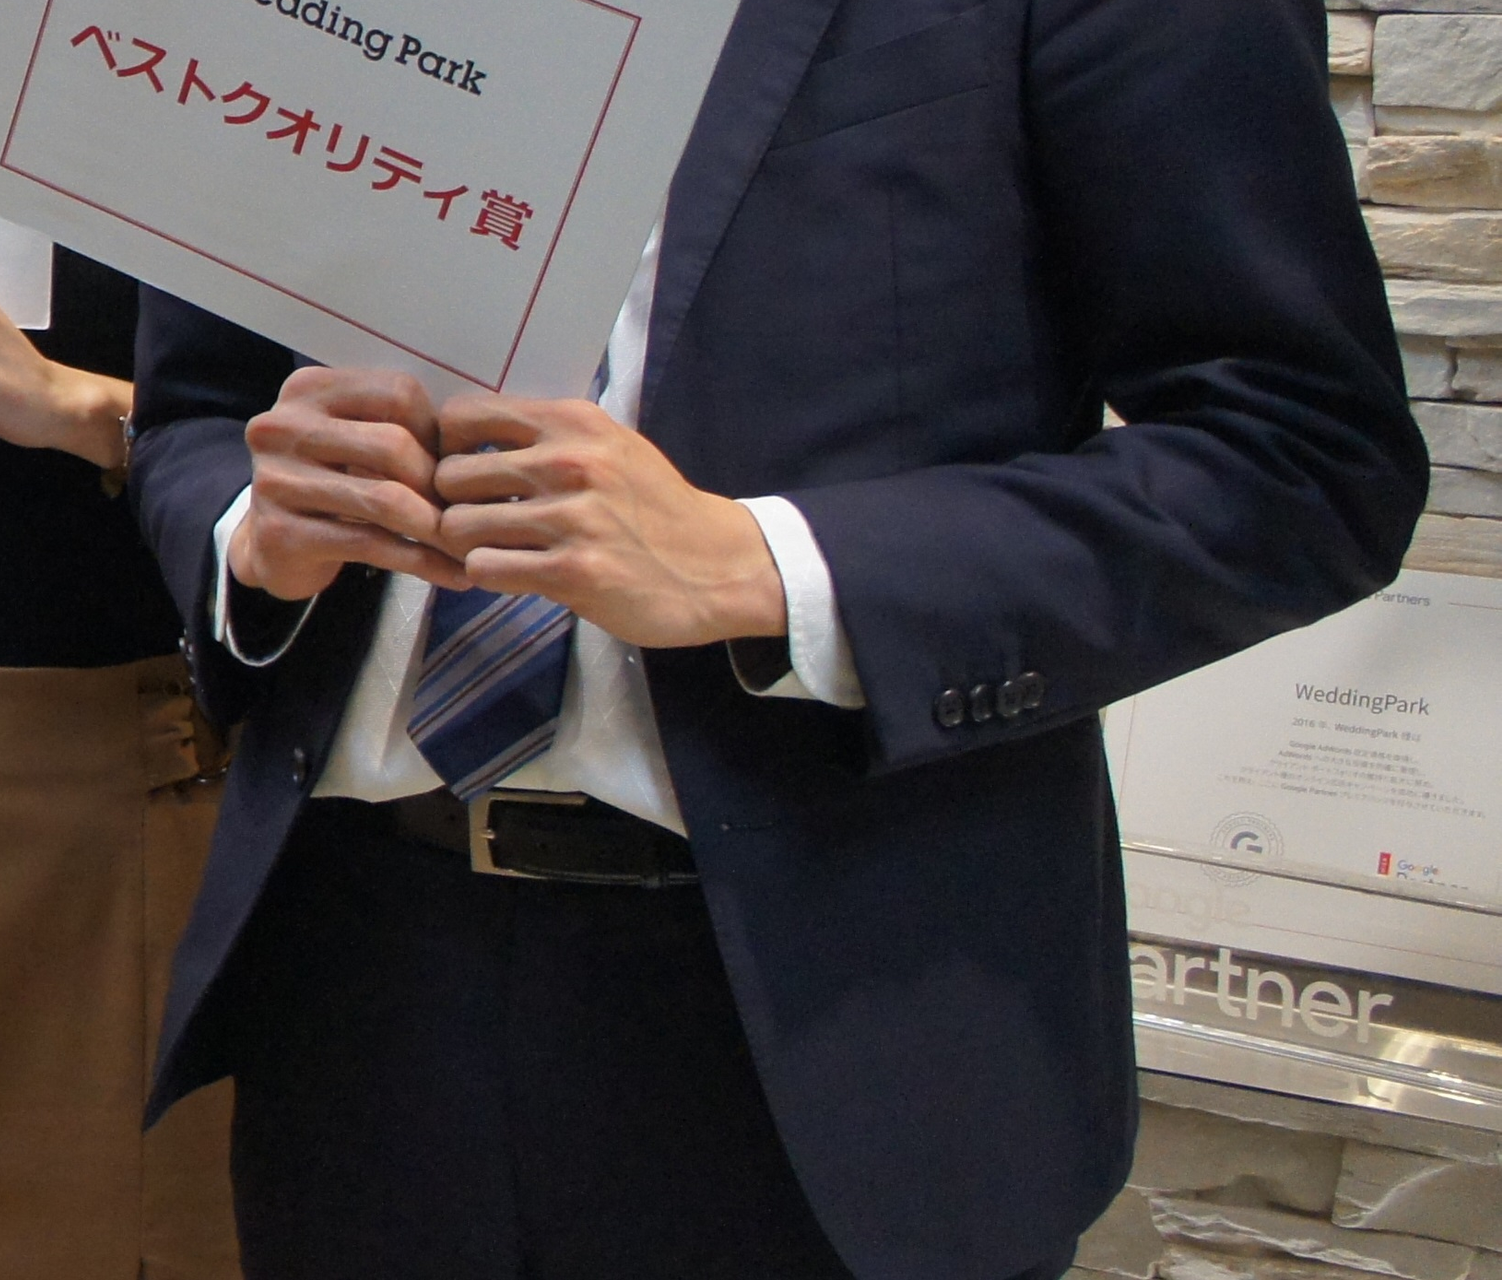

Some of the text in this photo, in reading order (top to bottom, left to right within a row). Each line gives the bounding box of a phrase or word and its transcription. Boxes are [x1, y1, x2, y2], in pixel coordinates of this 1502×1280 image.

[393, 32, 488, 96] Park
[69, 23, 534, 251] ベストクオリティ賞
[1294, 682, 1431, 717] WeddingPark
[1334, 722, 1399, 740] WeddingPark
[1129, 943, 1394, 1044] artner
